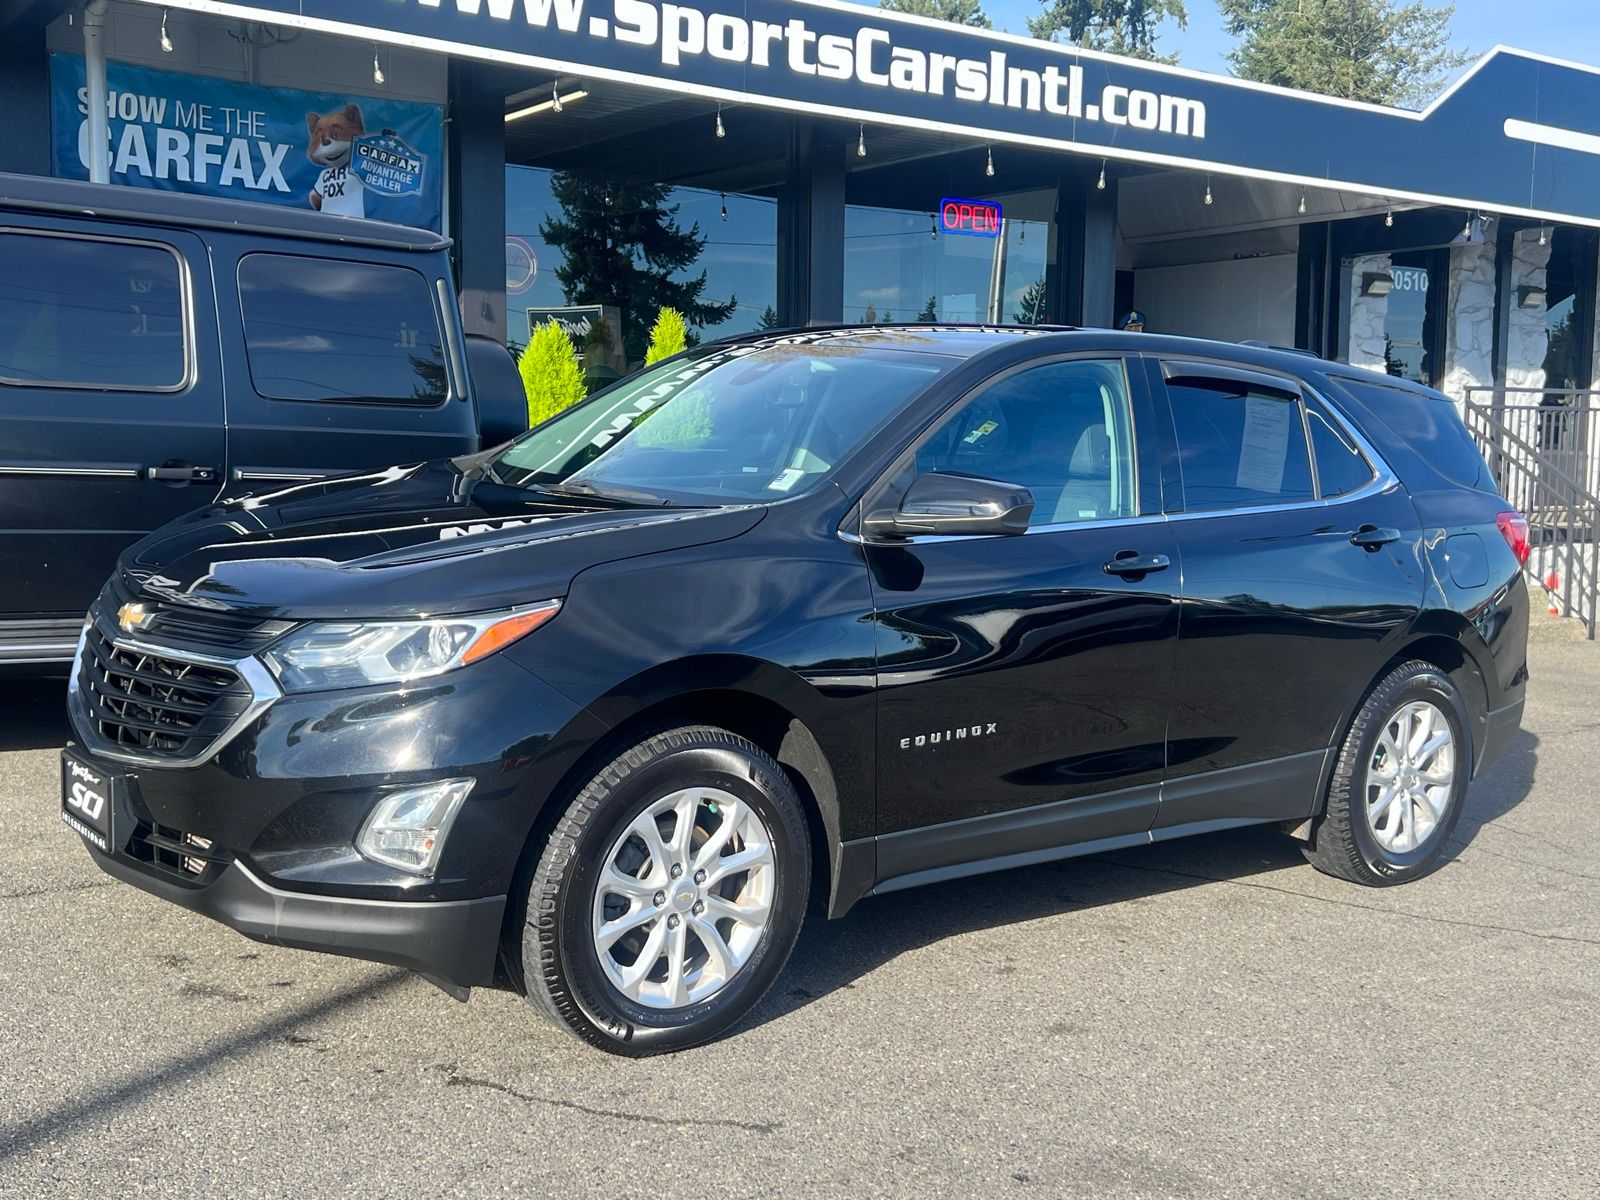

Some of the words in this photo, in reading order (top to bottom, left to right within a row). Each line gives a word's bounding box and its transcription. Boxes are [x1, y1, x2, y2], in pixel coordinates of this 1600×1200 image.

[417, 0, 1206, 138] w.SportsCarsIntl.com
[175, 100, 213, 131] ME
[219, 107, 266, 138] THE
[358, 145, 420, 174] CARFAX
[360, 159, 413, 185] ADVANTAGE
[322, 166, 347, 184] CAR
[365, 172, 402, 193] DEALER
[322, 181, 346, 200] FOX
[943, 203, 998, 232] OPEN
[899, 722, 998, 749] EQUINOX
